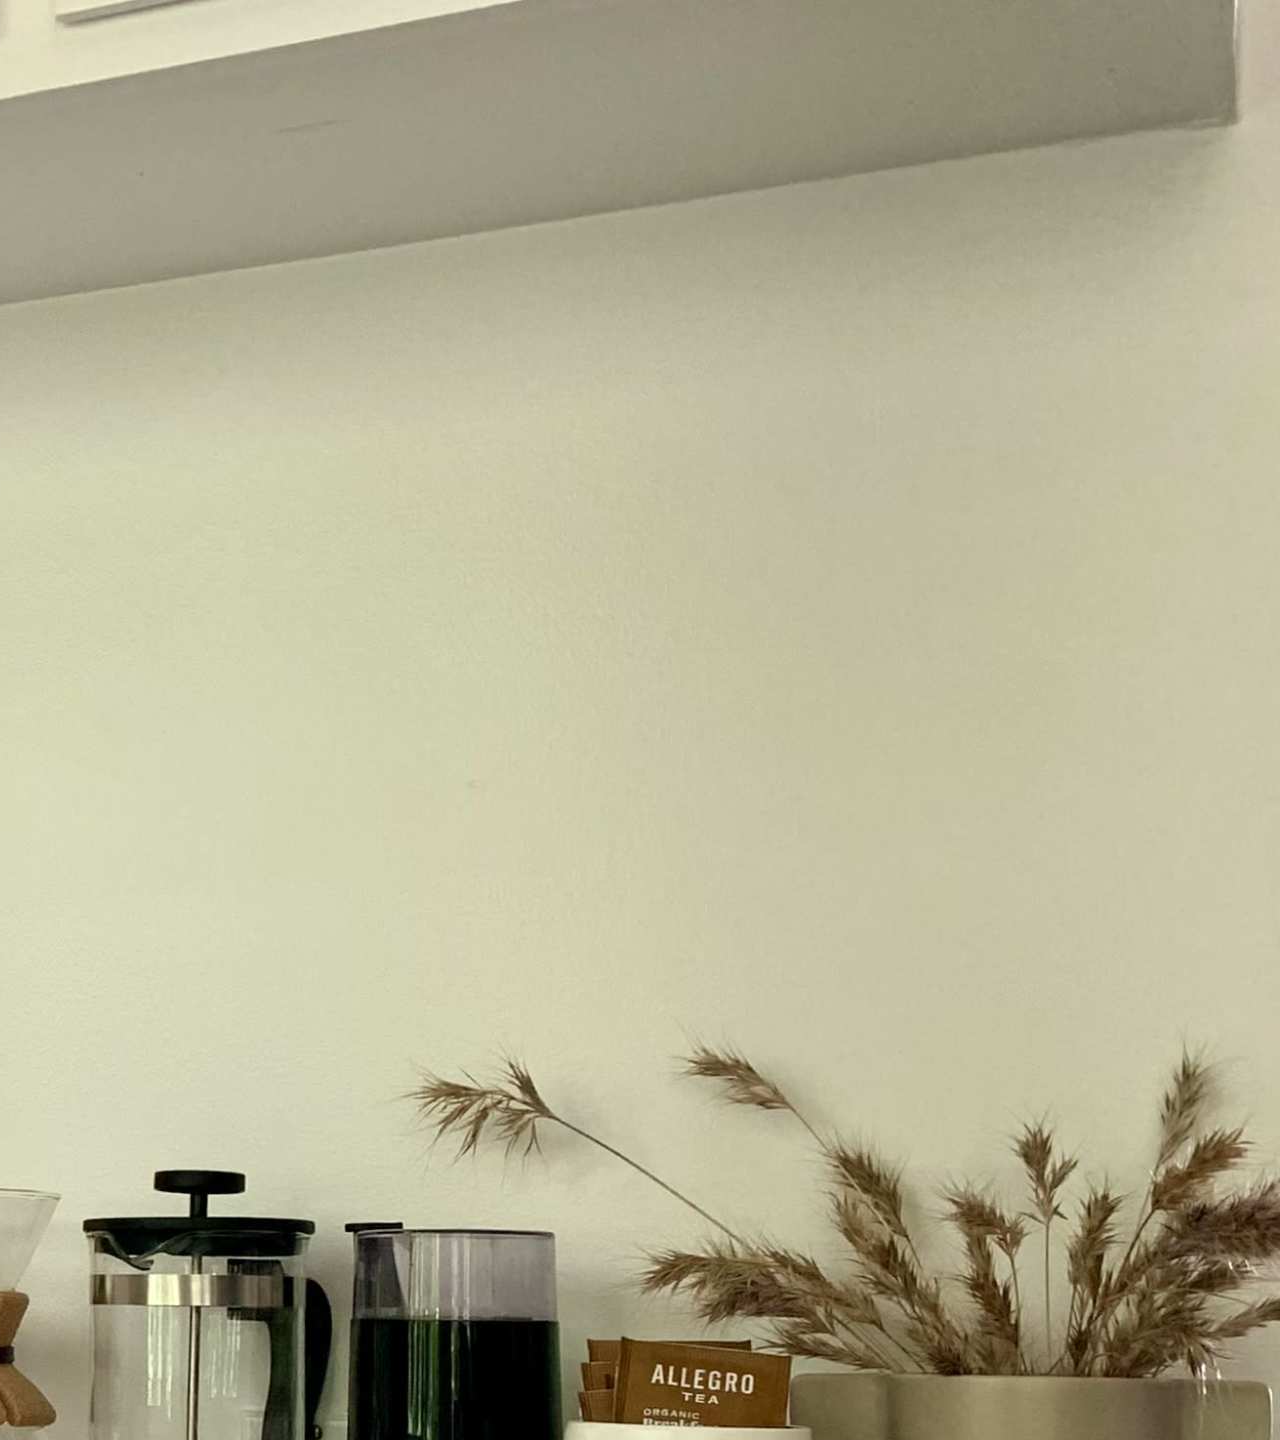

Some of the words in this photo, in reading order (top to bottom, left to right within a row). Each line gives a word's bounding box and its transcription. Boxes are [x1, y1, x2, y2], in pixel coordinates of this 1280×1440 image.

[651, 1364, 755, 1394] ALLEGRO
[681, 1391, 720, 1405] TEA
[643, 1407, 701, 1420] ORGANIC
